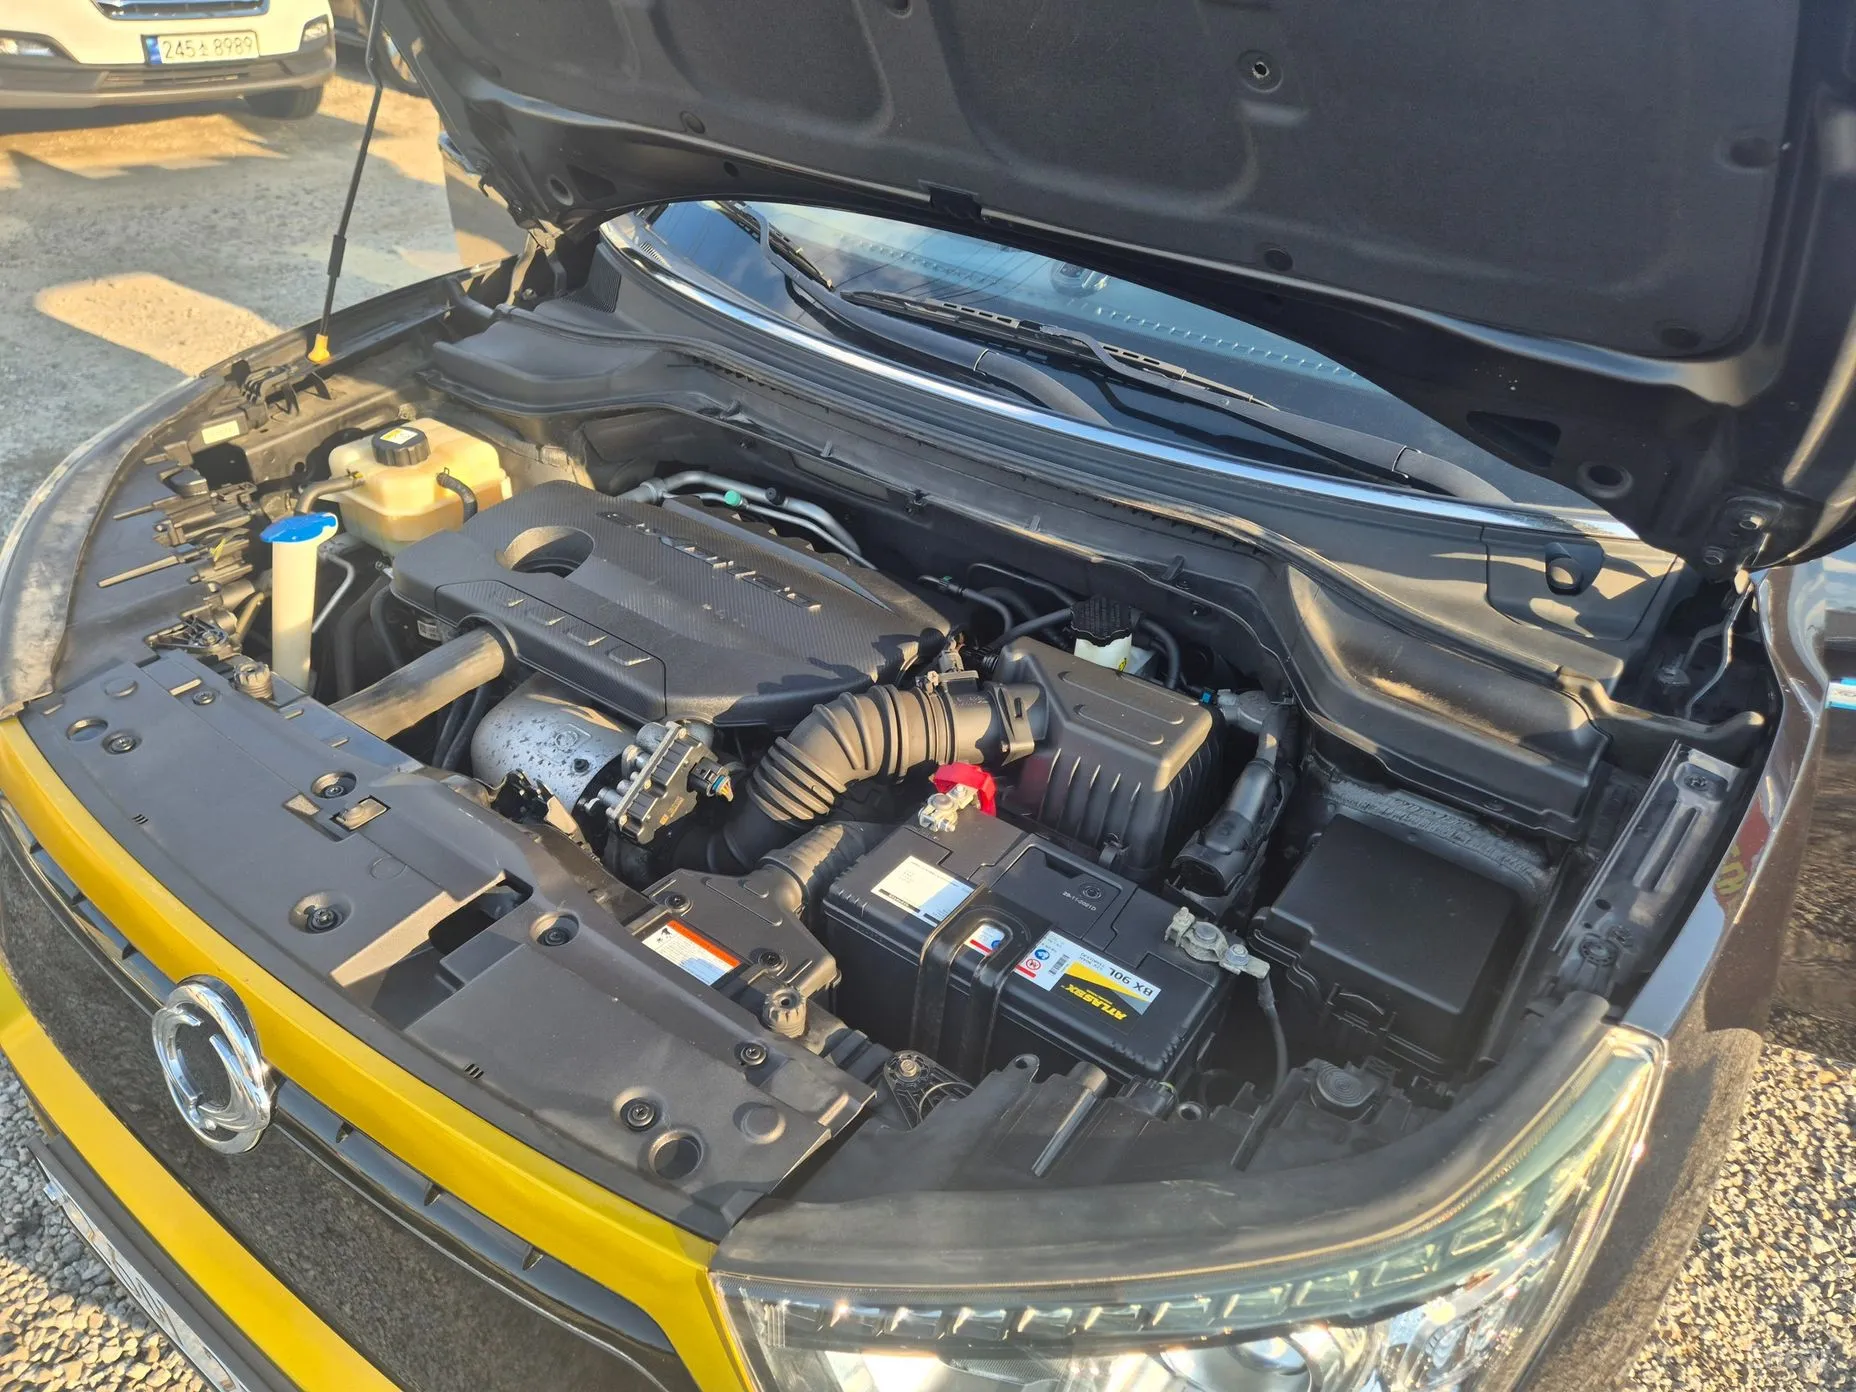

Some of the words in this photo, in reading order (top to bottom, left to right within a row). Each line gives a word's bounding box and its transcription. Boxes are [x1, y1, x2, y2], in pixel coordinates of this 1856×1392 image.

[213, 36, 253, 56] 8989
[1109, 967, 1131, 985] 90L
[1133, 982, 1153, 997] BX
[1065, 983, 1128, 1020] ATLASBX
